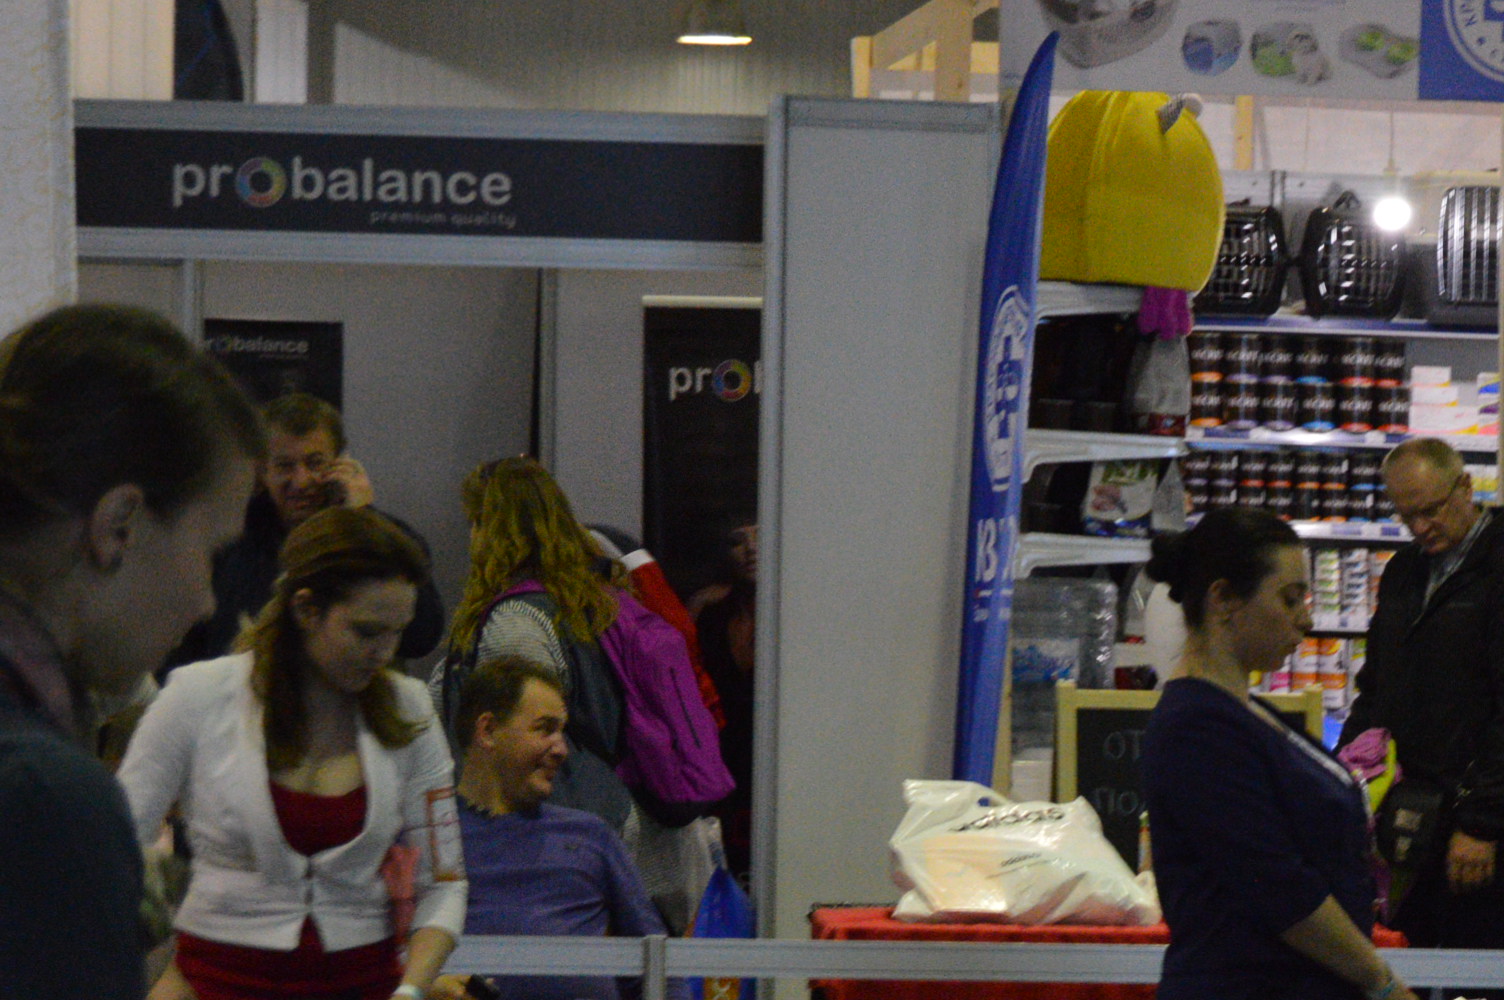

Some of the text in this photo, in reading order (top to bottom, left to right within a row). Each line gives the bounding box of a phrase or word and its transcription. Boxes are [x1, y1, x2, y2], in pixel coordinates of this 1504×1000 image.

[172, 155, 513, 207] probalance
[370, 210, 517, 229] premium quality
